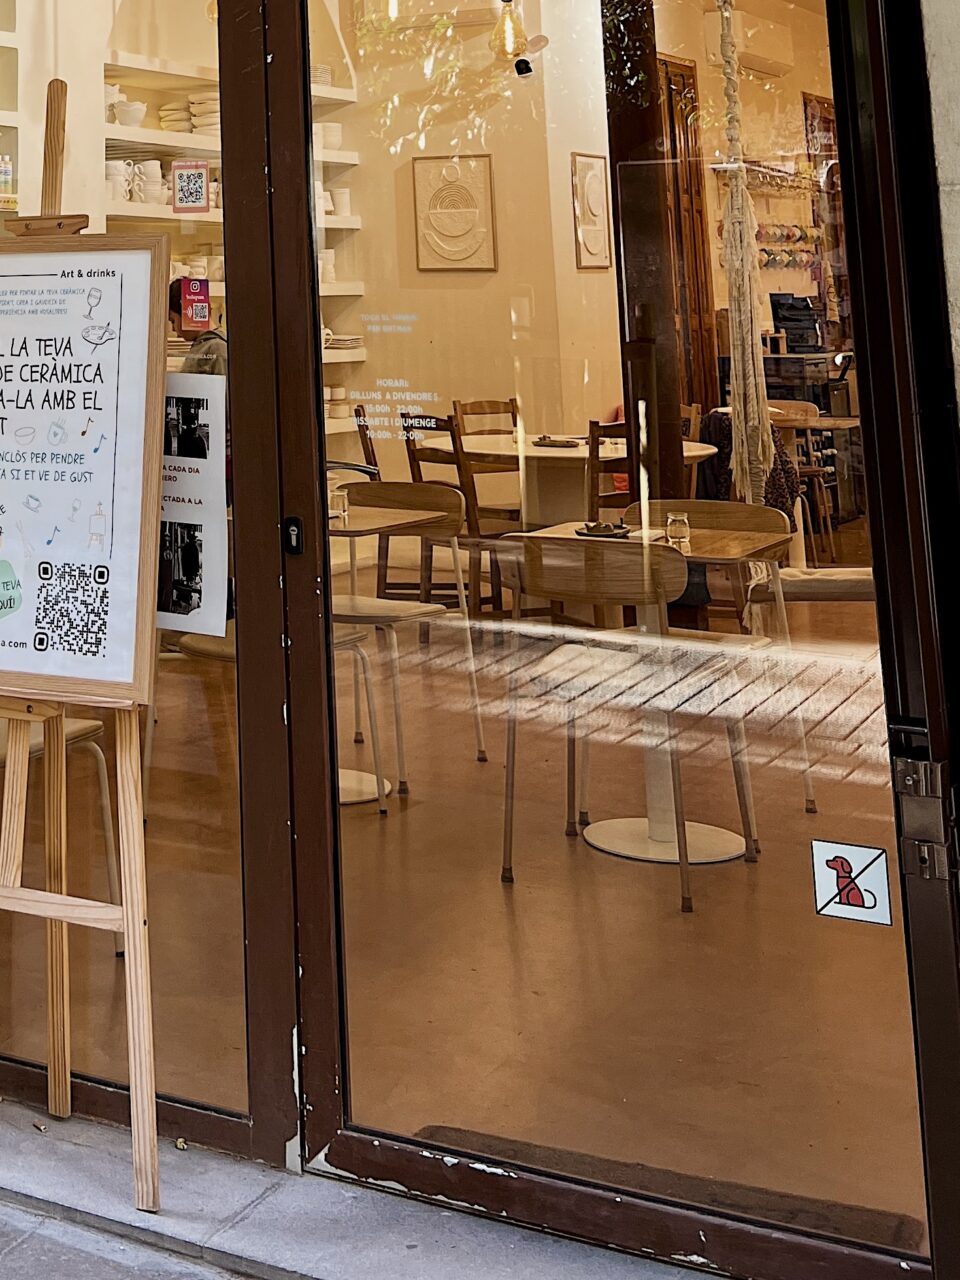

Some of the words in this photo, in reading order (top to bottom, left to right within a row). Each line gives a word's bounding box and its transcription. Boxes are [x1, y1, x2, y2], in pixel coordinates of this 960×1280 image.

[60, 269, 74, 279] Art
[77, 270, 83, 278] &
[86, 269, 116, 278] drinks
[10, 337, 29, 357] LA
[35, 336, 73, 357] TEVA
[19, 357, 104, 384] CERÀMICA
[41, 389, 76, 410] AMB
[83, 390, 103, 411] EL
[350, 391, 382, 400] DILLUNS
[385, 391, 391, 400] A
[395, 418, 436, 428] DIUMENGE
[30, 452, 47, 464] PER
[50, 452, 86, 465] PENDRE
[168, 464, 186, 473] CADA
[10, 469, 21, 480] SI
[24, 470, 36, 480] ET
[39, 470, 50, 481] VE
[53, 471, 66, 481] DE
[70, 471, 94, 483] GUST
[161, 495, 186, 504] CTADA
[2, 579, 23, 592] TEVA
